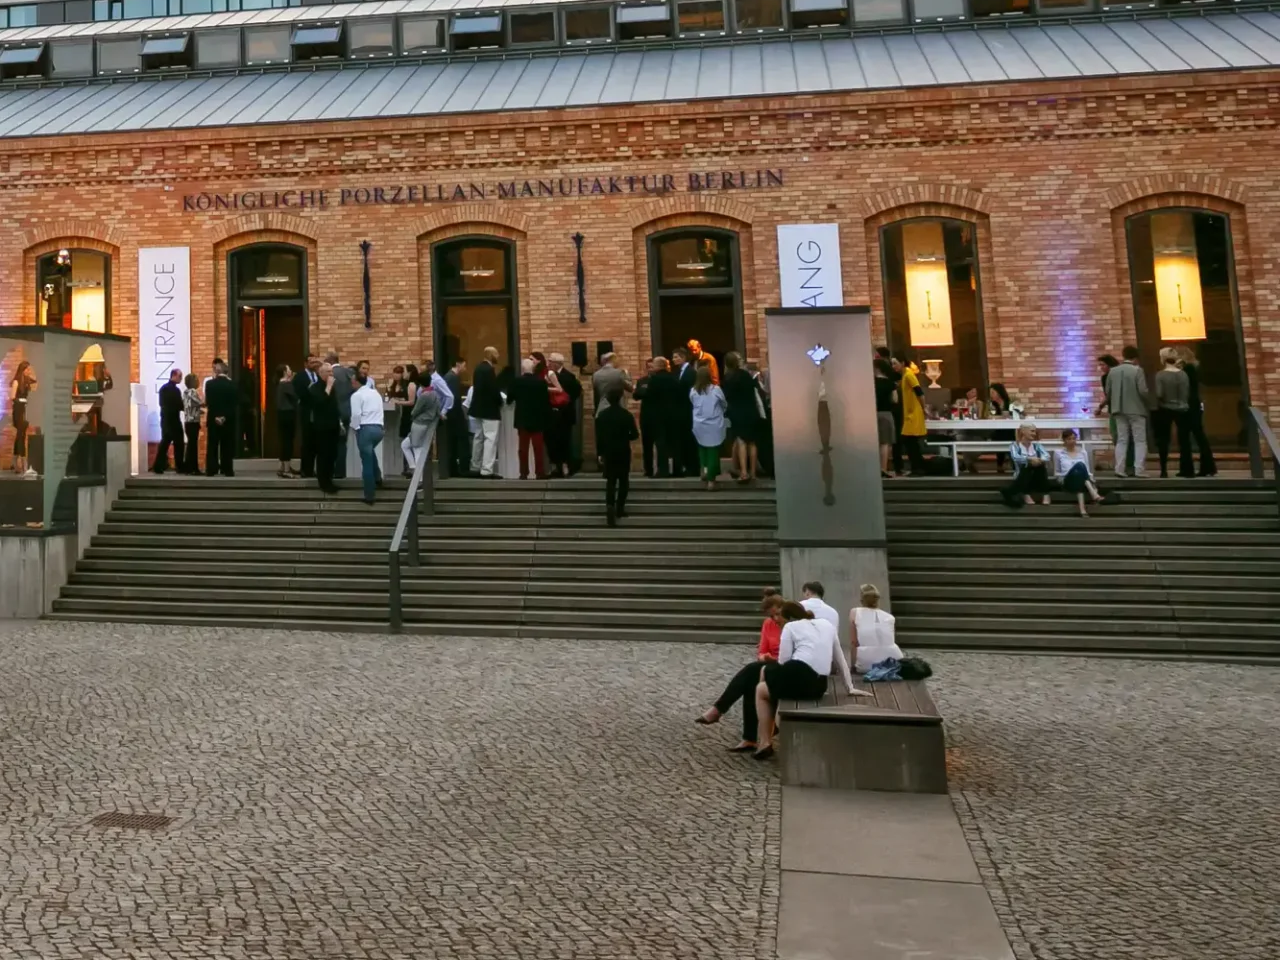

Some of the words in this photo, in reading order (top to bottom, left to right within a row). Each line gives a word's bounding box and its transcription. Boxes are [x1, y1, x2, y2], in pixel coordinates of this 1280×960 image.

[182, 189, 330, 211] KÖNIGLICHE
[339, 173, 676, 206] PORZELLAN-MANUFAKTUR
[687, 168, 785, 191] BERLIN
